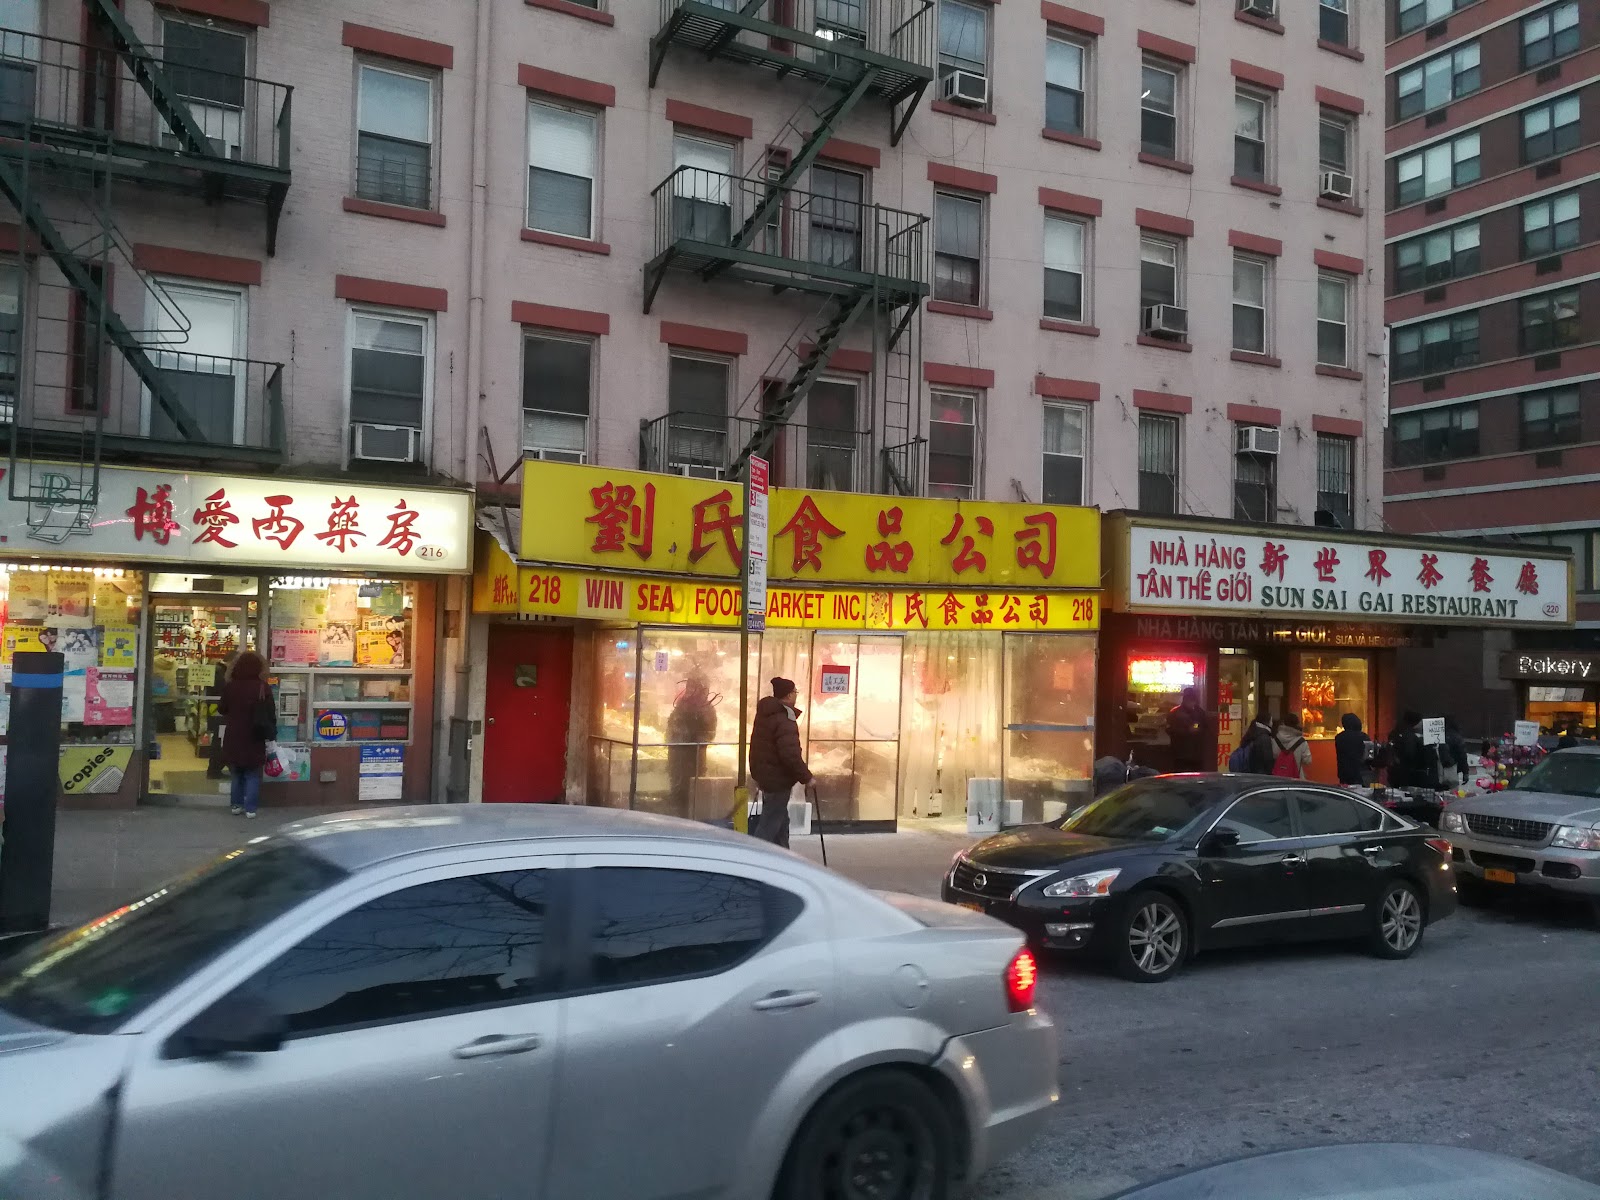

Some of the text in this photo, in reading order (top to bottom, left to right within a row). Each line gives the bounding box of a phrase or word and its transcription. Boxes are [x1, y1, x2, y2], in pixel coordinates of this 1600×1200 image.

[126, 482, 422, 556] 博愛西藥房
[585, 481, 1057, 579] 劉氏食品公司
[421, 546, 443, 558] 216
[1150, 536, 1246, 569] NHÀ HÀNG
[1137, 568, 1173, 598] TÂN
[1259, 542, 1539, 596] 新世界茶餐廳
[529, 575, 865, 620] 218 WIN SEA FOOD ARKET INC.
[1072, 597, 1093, 621] 218
[1261, 585, 1518, 618] SUN SAI GAI RESTAURANT
[1546, 604, 1559, 614] 220
[1519, 656, 1591, 677] Bakery
[64, 746, 114, 790] copies
